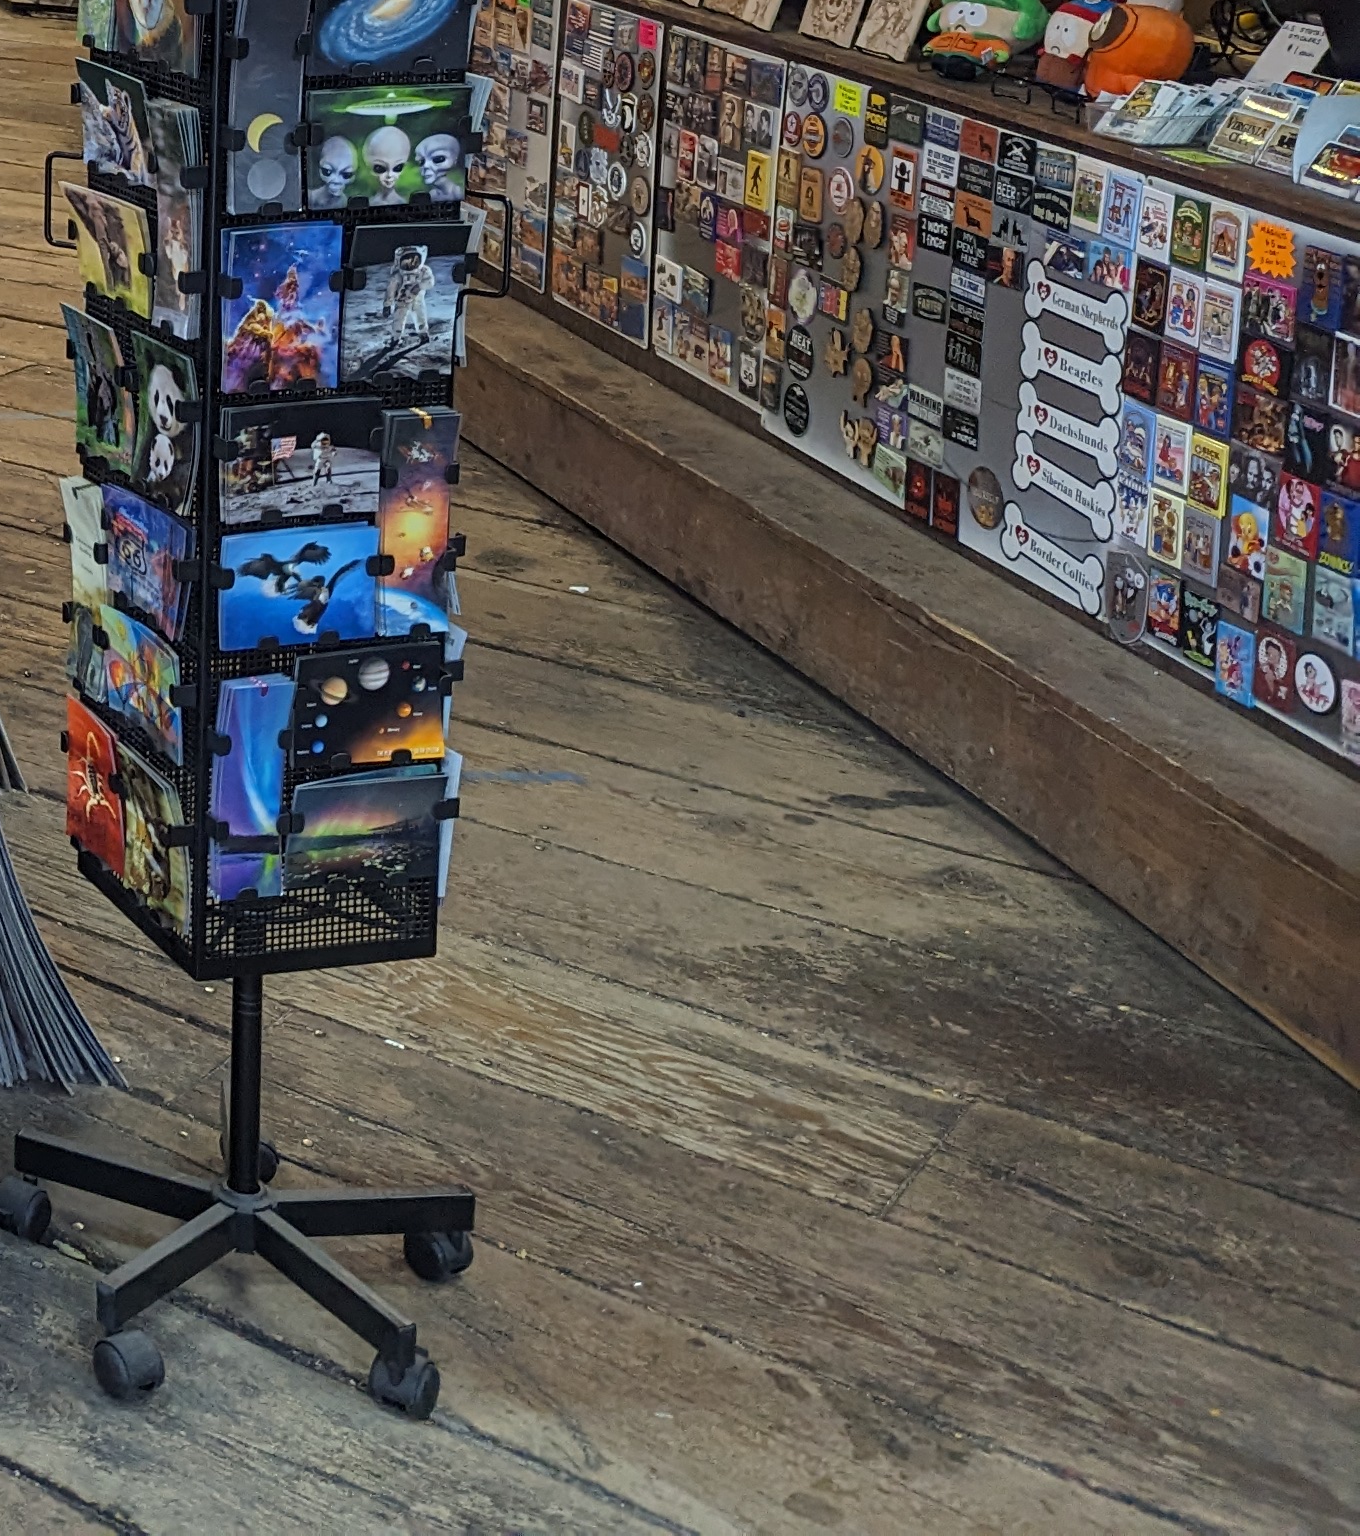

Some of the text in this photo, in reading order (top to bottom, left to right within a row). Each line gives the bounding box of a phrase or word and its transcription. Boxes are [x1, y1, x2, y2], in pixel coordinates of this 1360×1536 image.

[1226, 116, 1268, 139] VIRGINIA
[1038, 161, 1072, 185] BIGFOOT
[996, 181, 1016, 203] BEER
[1052, 292, 1119, 331] German Shepherds
[1060, 357, 1104, 389] Beagles
[908, 391, 943, 415] WARNING
[1049, 415, 1110, 454] Dachshunds
[1042, 467, 1107, 519] Siberian Huskies
[121, 540, 146, 571] 66
[1030, 539, 1095, 593] Border Collies
